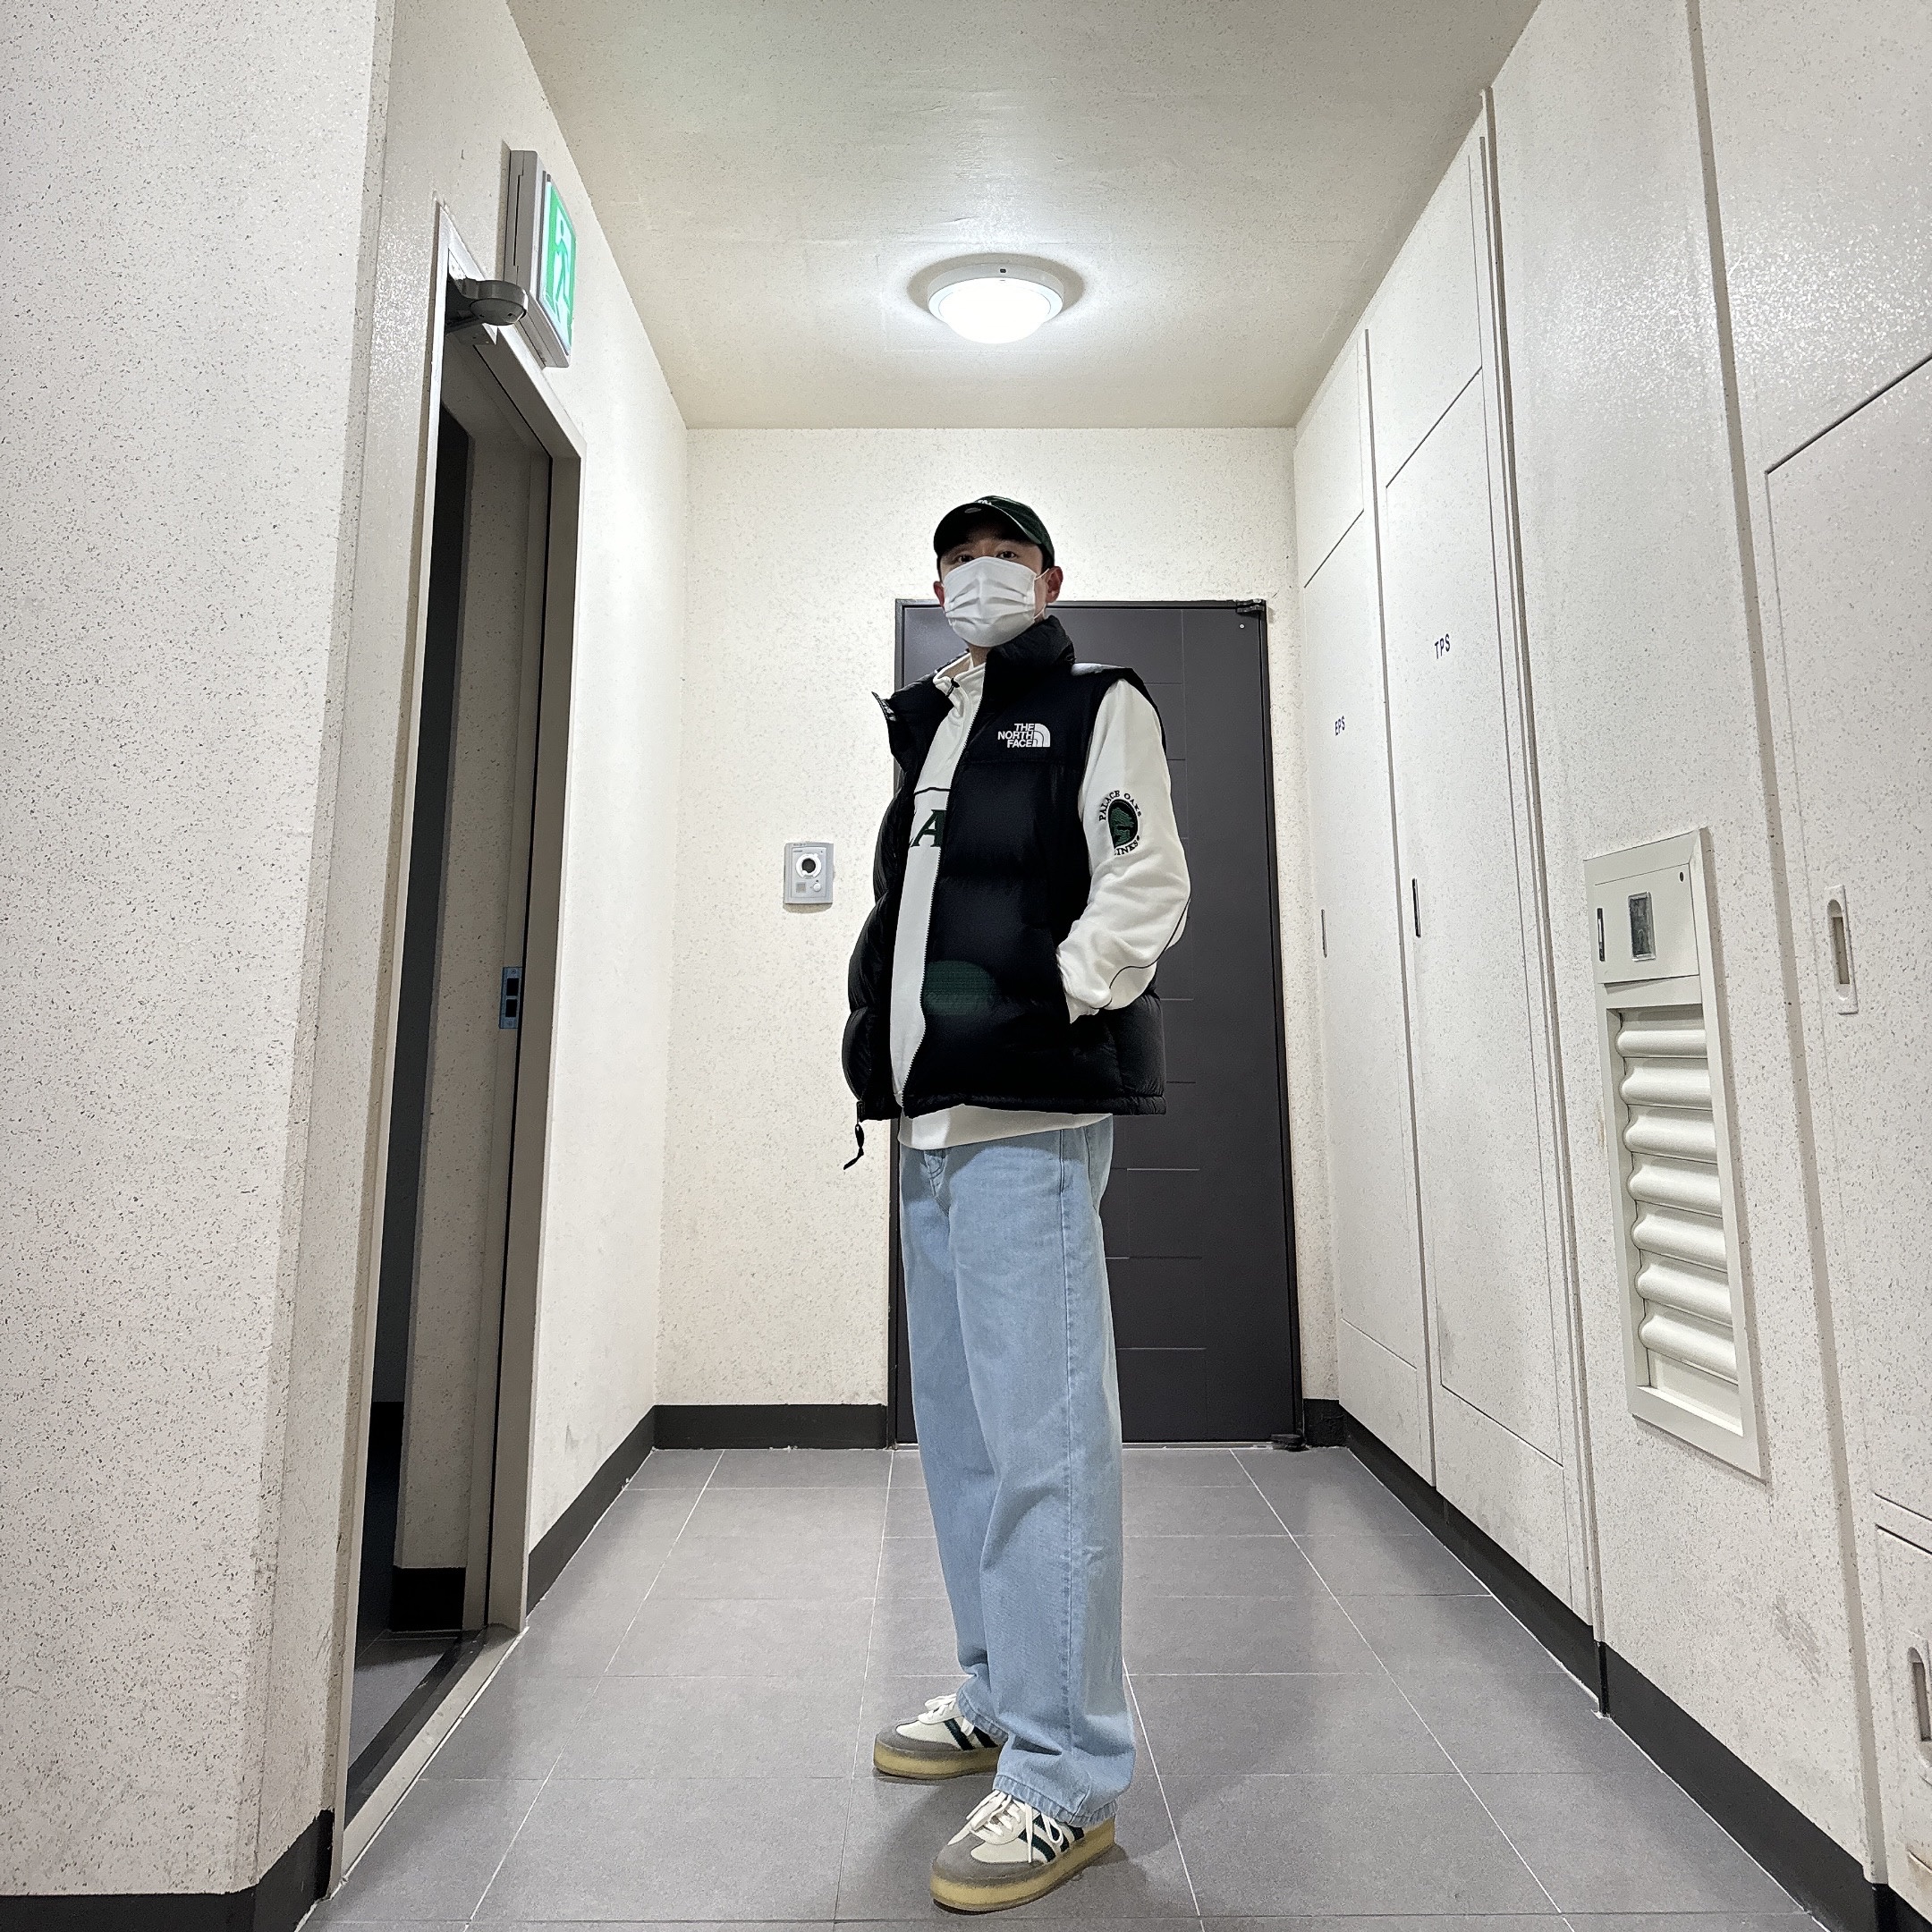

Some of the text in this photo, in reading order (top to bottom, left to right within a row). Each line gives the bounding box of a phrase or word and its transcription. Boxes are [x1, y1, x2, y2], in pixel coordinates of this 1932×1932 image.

[1434, 633, 1451, 660] TPS
[1014, 723, 1035, 732] THE
[1335, 716, 1345, 736] EPS
[997, 730, 1034, 741] NORTH
[1006, 739, 1032, 749] FACE
[1098, 790, 1142, 821] PALACE OAKS
[910, 809, 946, 848] A
[1114, 839, 1139, 856] INKS
